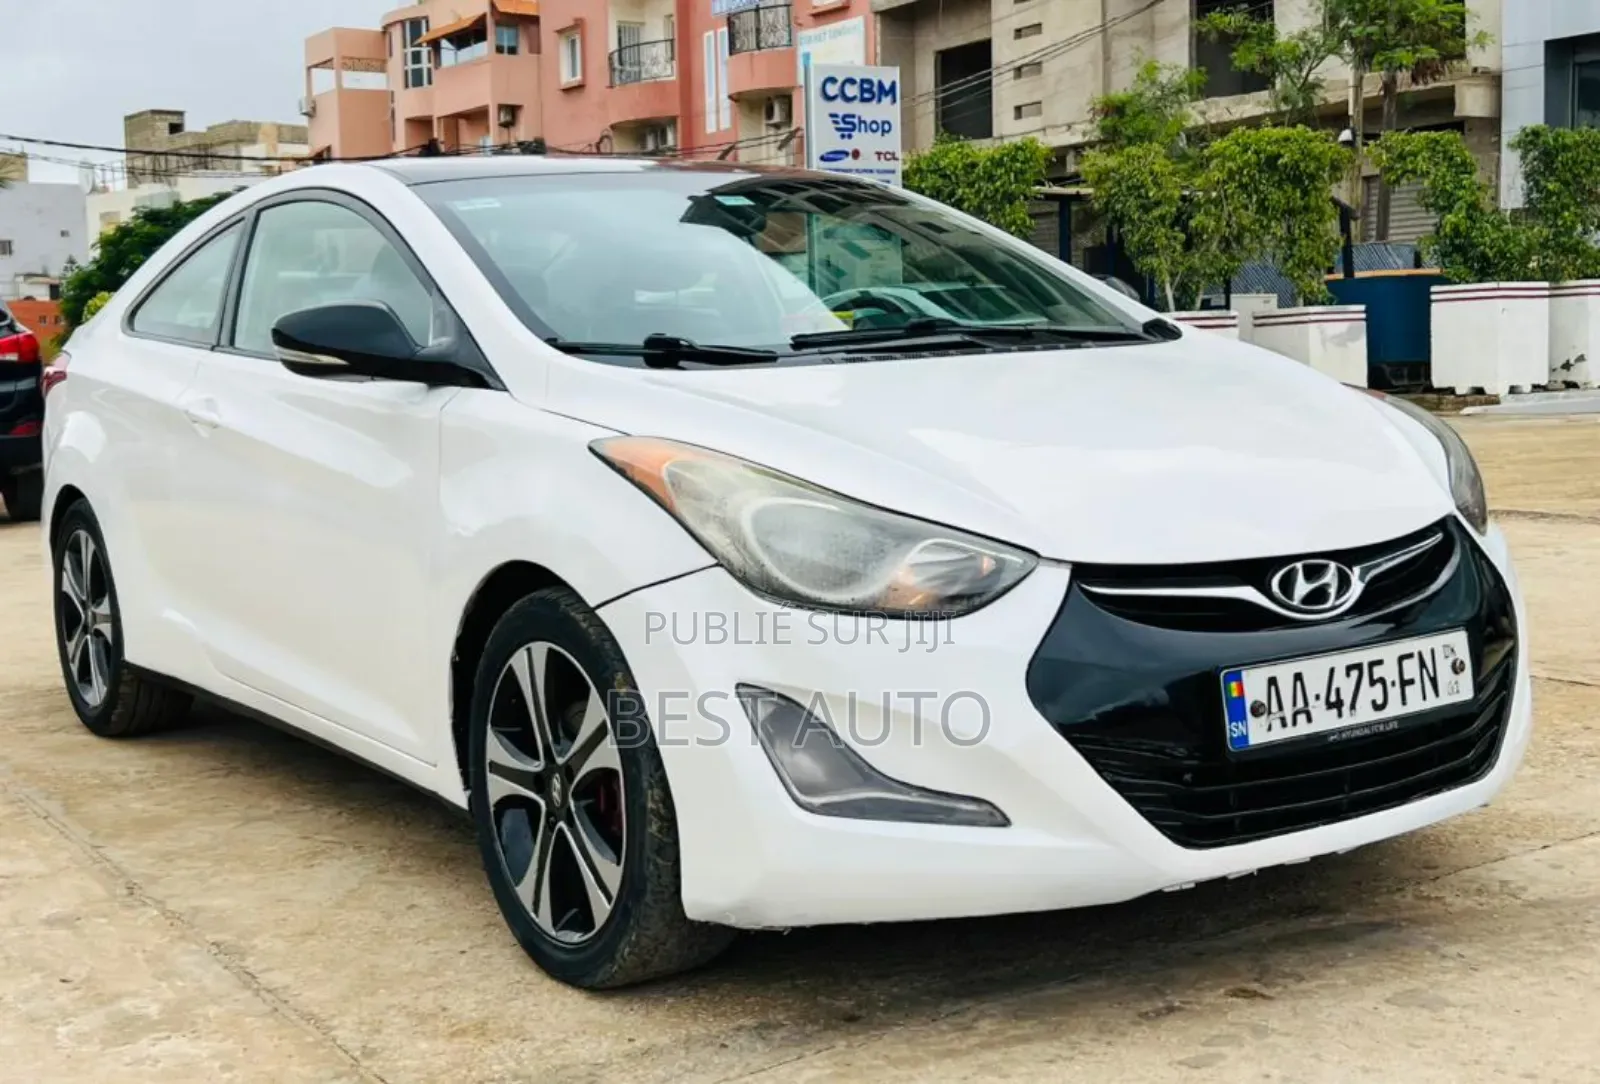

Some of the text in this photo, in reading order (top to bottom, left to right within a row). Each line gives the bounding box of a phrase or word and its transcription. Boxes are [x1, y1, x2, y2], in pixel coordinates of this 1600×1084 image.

[821, 76, 897, 105] CCBM
[874, 150, 900, 161] TCL
[1230, 720, 1247, 737] SN
